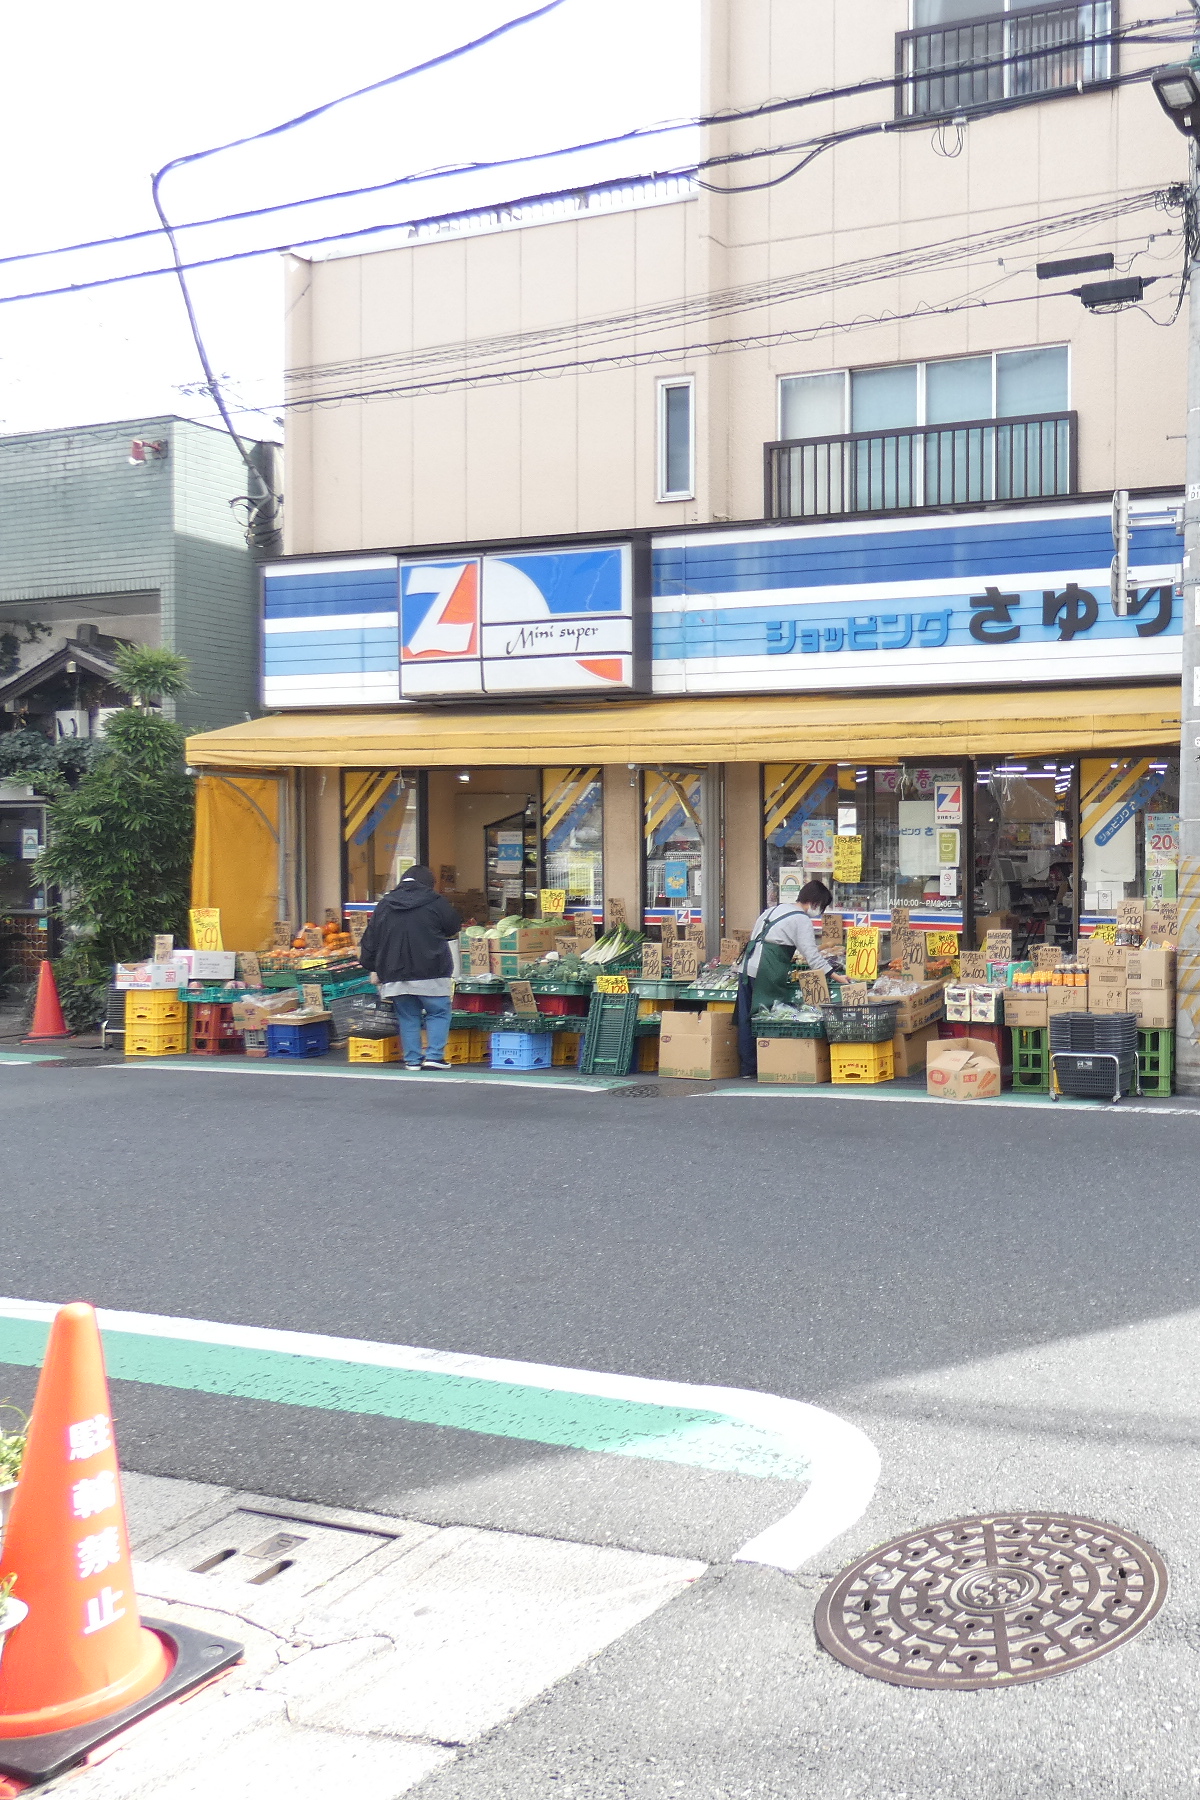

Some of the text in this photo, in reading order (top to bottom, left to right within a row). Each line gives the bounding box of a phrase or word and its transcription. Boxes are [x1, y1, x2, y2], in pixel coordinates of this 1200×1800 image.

[505, 626, 600, 656] Mini super
[766, 583, 1173, 655] ショッピング さゆり
[68, 1413, 126, 1635] 駐輪禁止
